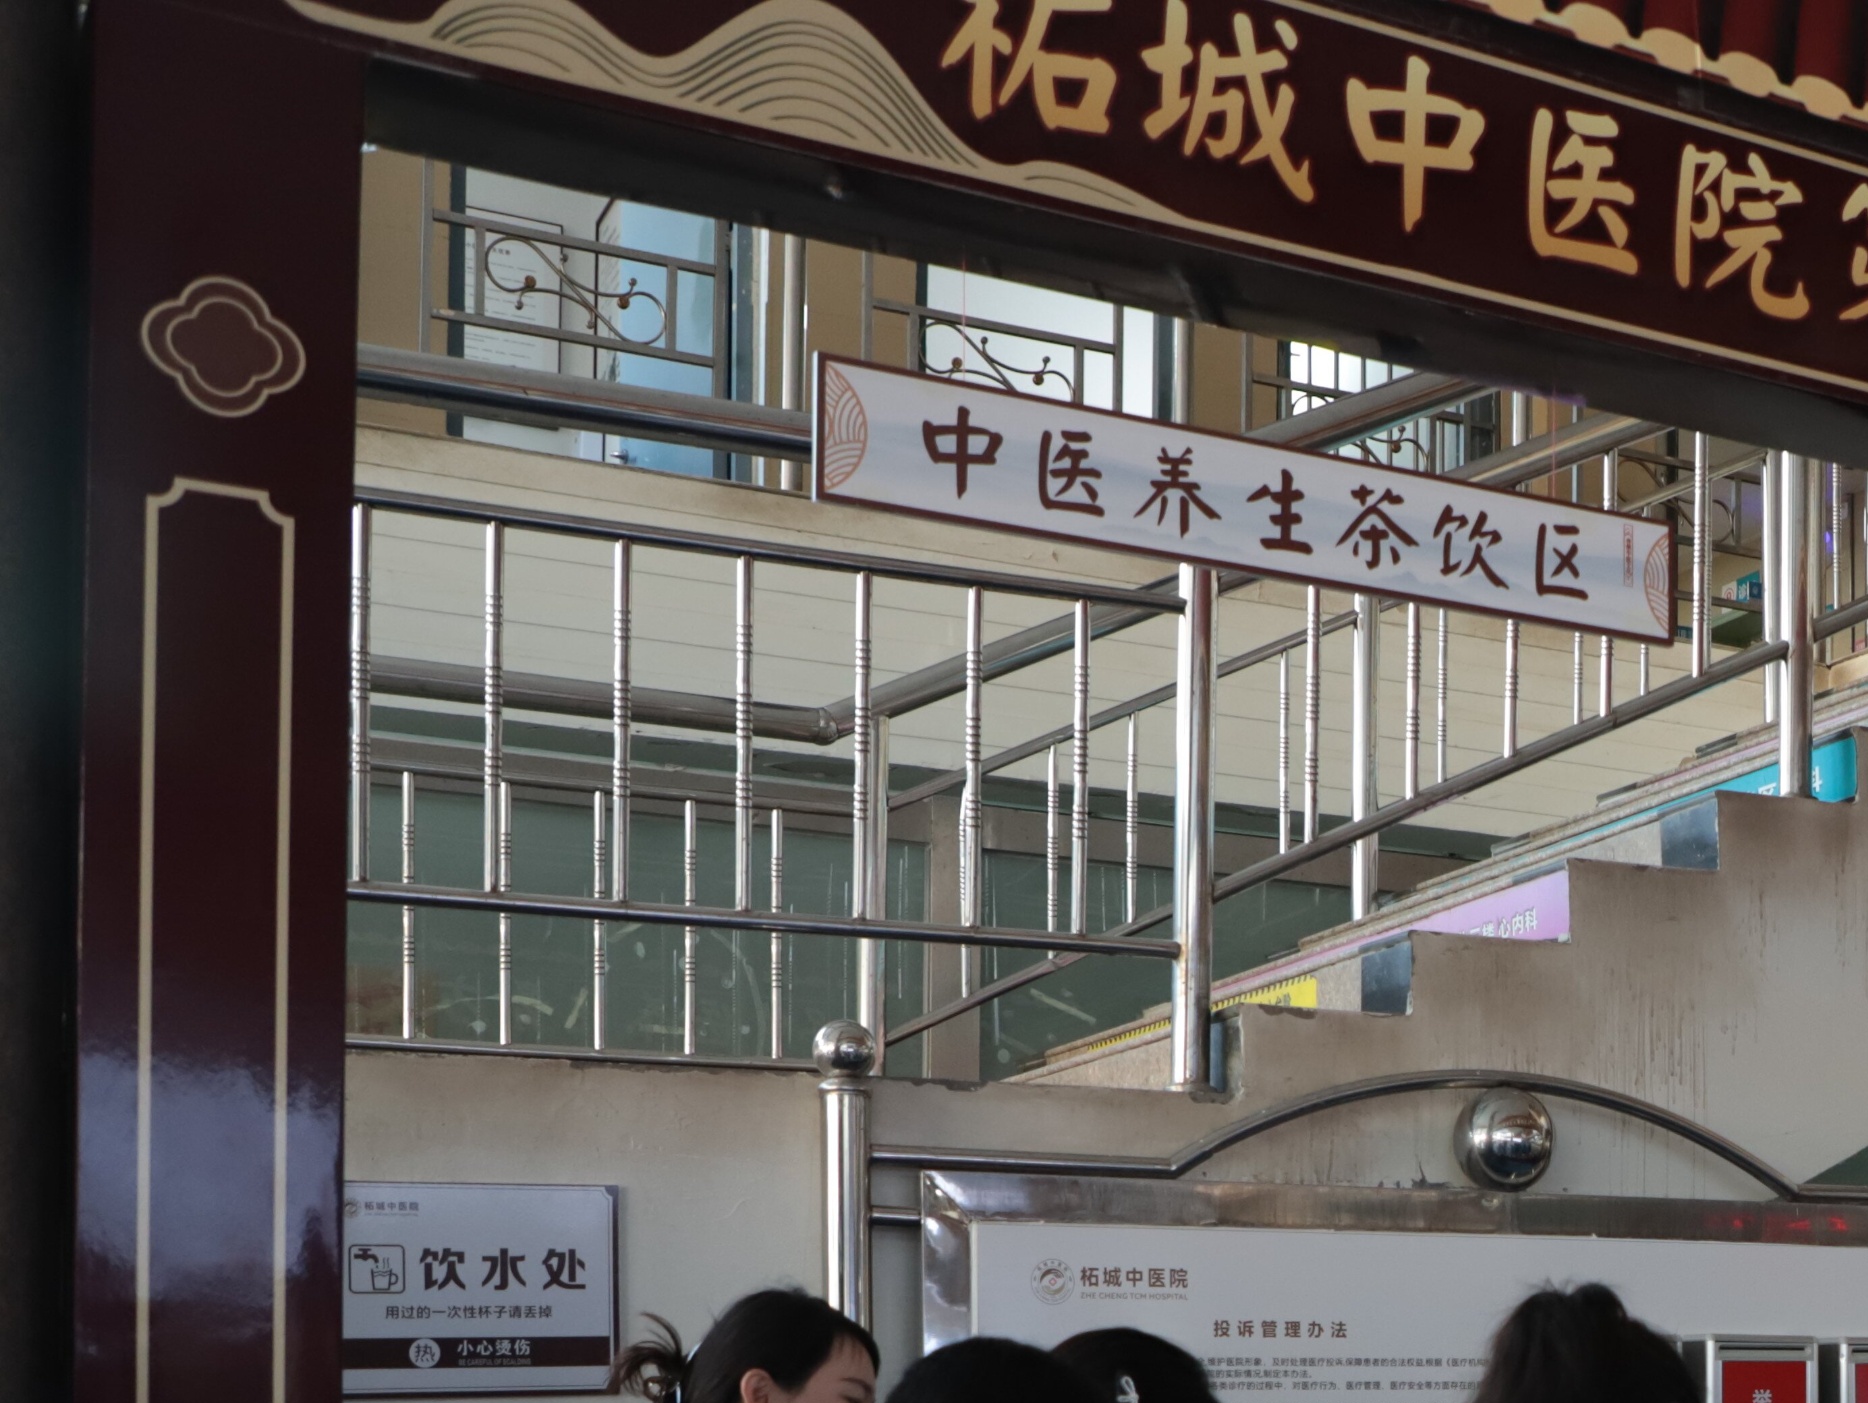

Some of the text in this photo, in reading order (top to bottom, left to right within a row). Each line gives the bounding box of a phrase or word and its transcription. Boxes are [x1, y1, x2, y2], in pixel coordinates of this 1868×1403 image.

[921, 405, 1590, 601] 中医养生茶饮区
[420, 1248, 586, 1291] 饮水处
[1080, 1267, 1189, 1289] 柘城中医院
[1080, 1292, 1189, 1301] ZHE CHENG TCM HOSPITAL
[385, 1304, 553, 1319] 用过的一次性杯子请丢掉
[1213, 1319, 1348, 1339] 投诉管理办法
[414, 1344, 436, 1363] 热
[457, 1339, 531, 1356] 小心烫伤
